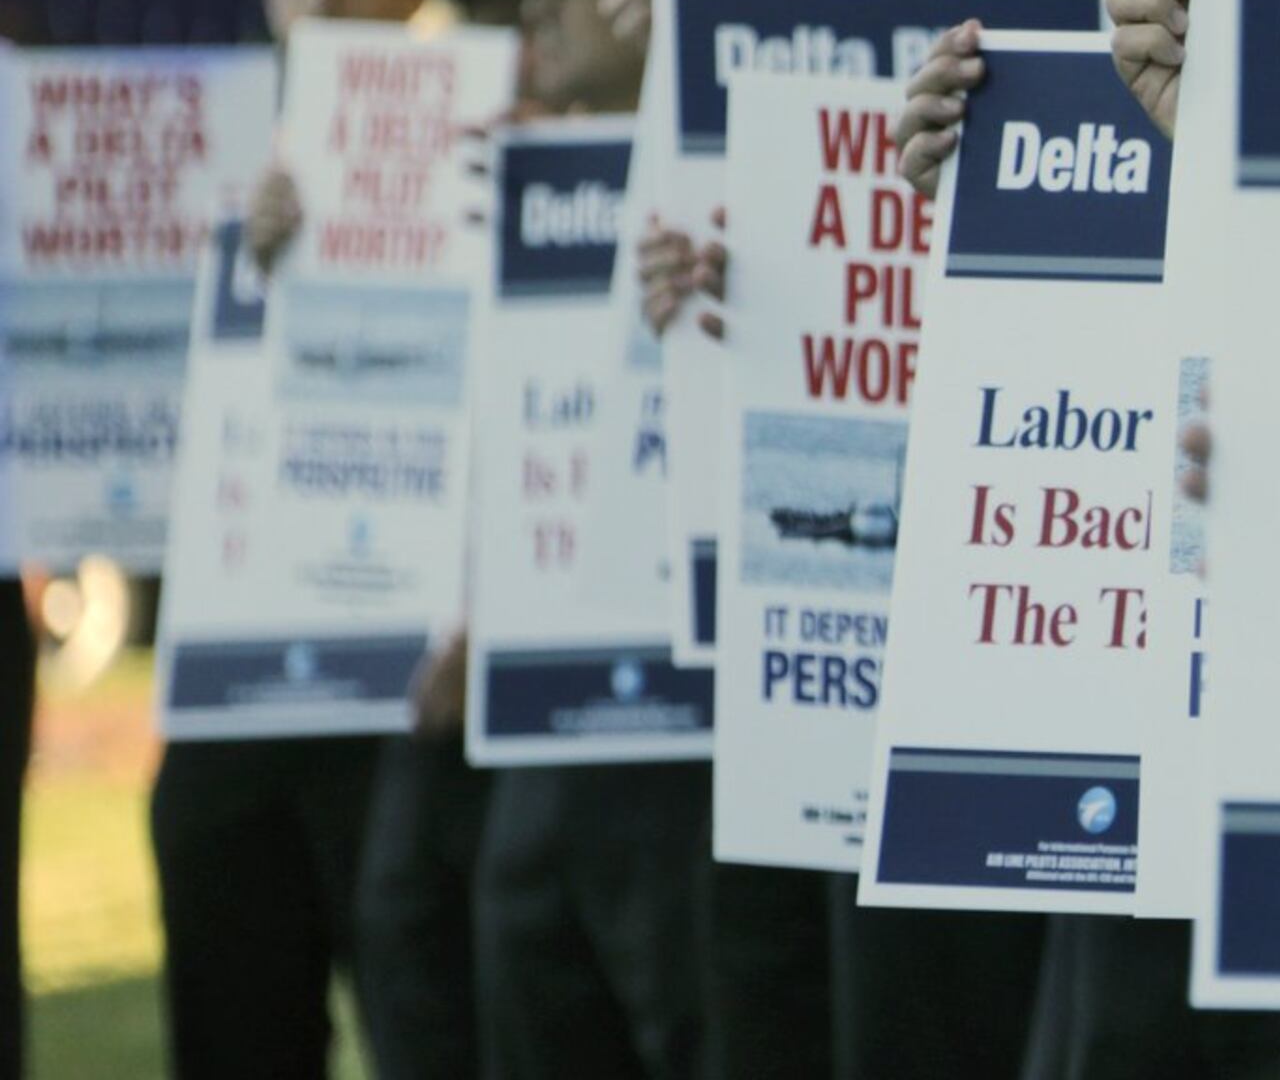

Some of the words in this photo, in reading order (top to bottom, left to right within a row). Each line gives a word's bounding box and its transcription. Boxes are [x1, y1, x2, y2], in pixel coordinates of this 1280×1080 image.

[996, 120, 1152, 194] Delta
[809, 184, 846, 249] A
[845, 263, 922, 328] PIL
[973, 386, 1154, 453] Labor
[967, 483, 1016, 548] Is
[1036, 485, 1152, 552] Bac
[764, 606, 787, 641] IT
[968, 582, 1079, 648] The
